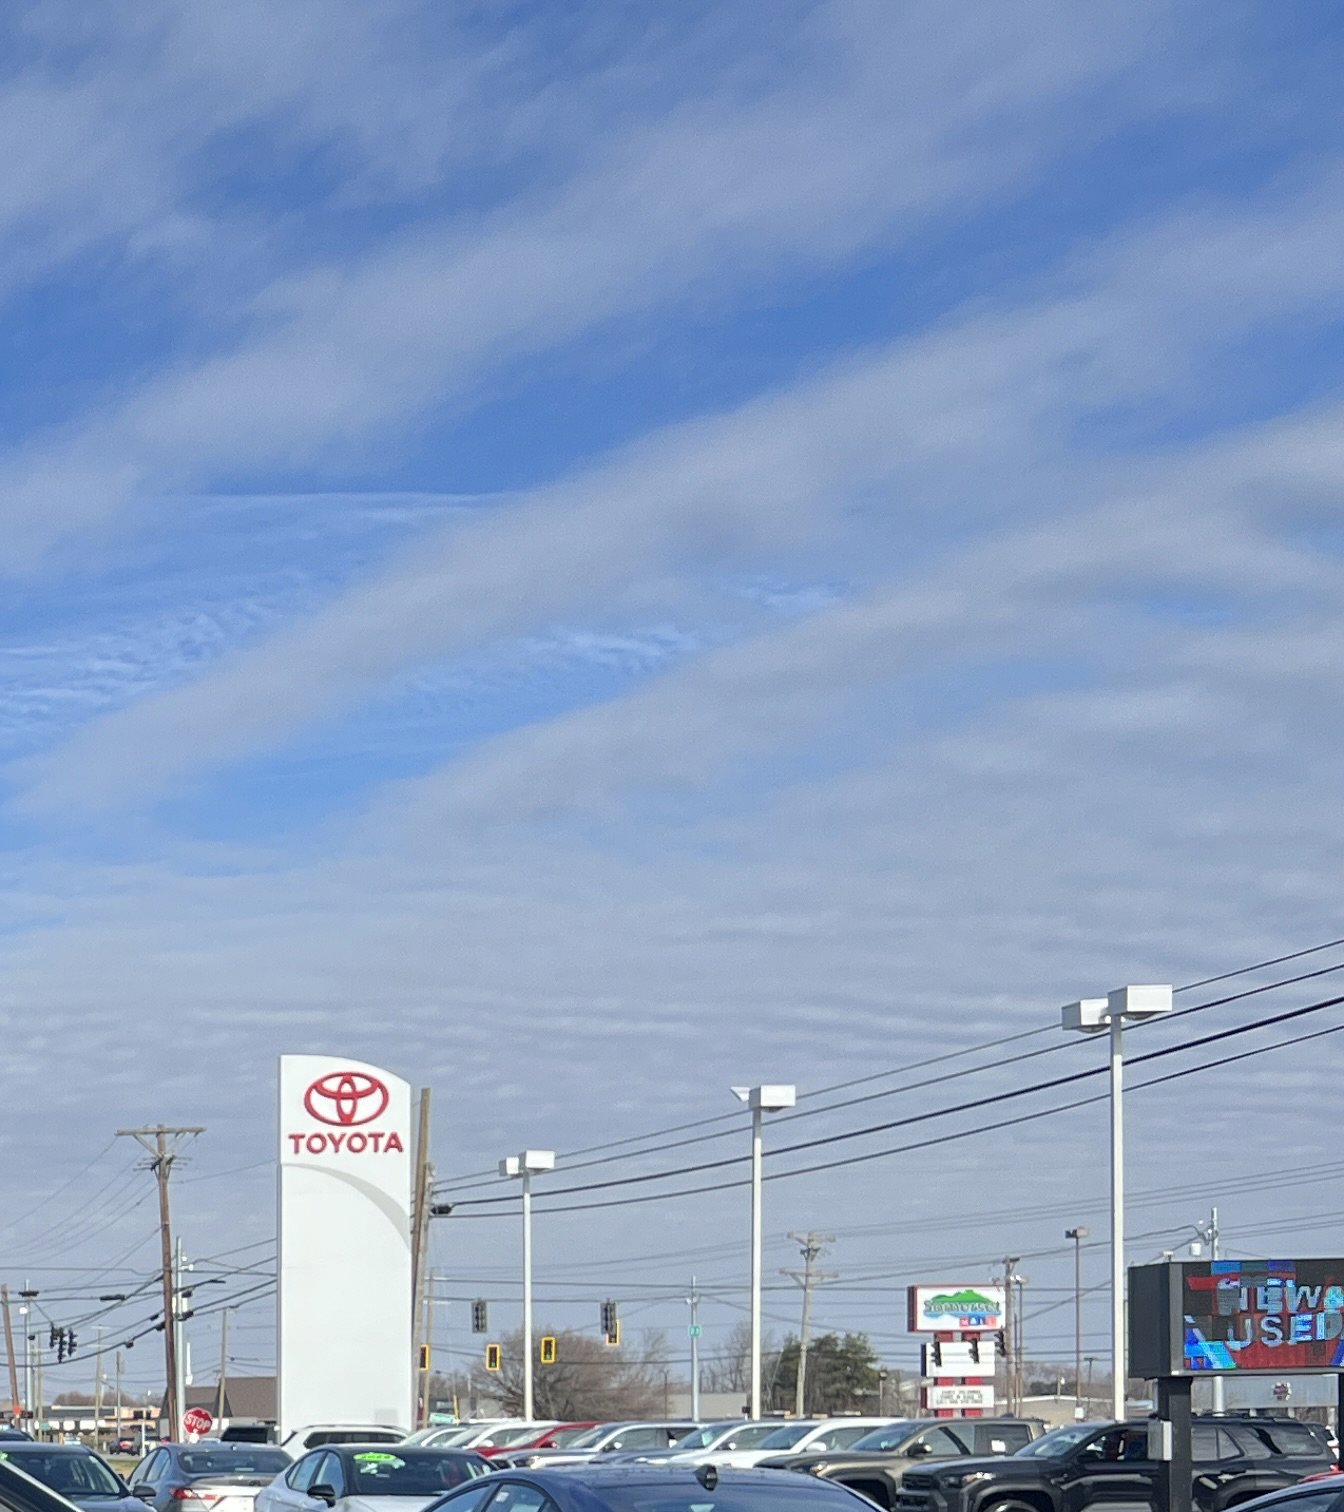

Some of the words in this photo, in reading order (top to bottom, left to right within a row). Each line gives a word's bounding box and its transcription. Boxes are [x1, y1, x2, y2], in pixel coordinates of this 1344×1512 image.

[288, 1132, 404, 1154] TOYOTA
[1226, 1312, 1343, 1351] USED
[185, 1413, 211, 1430] STOP
